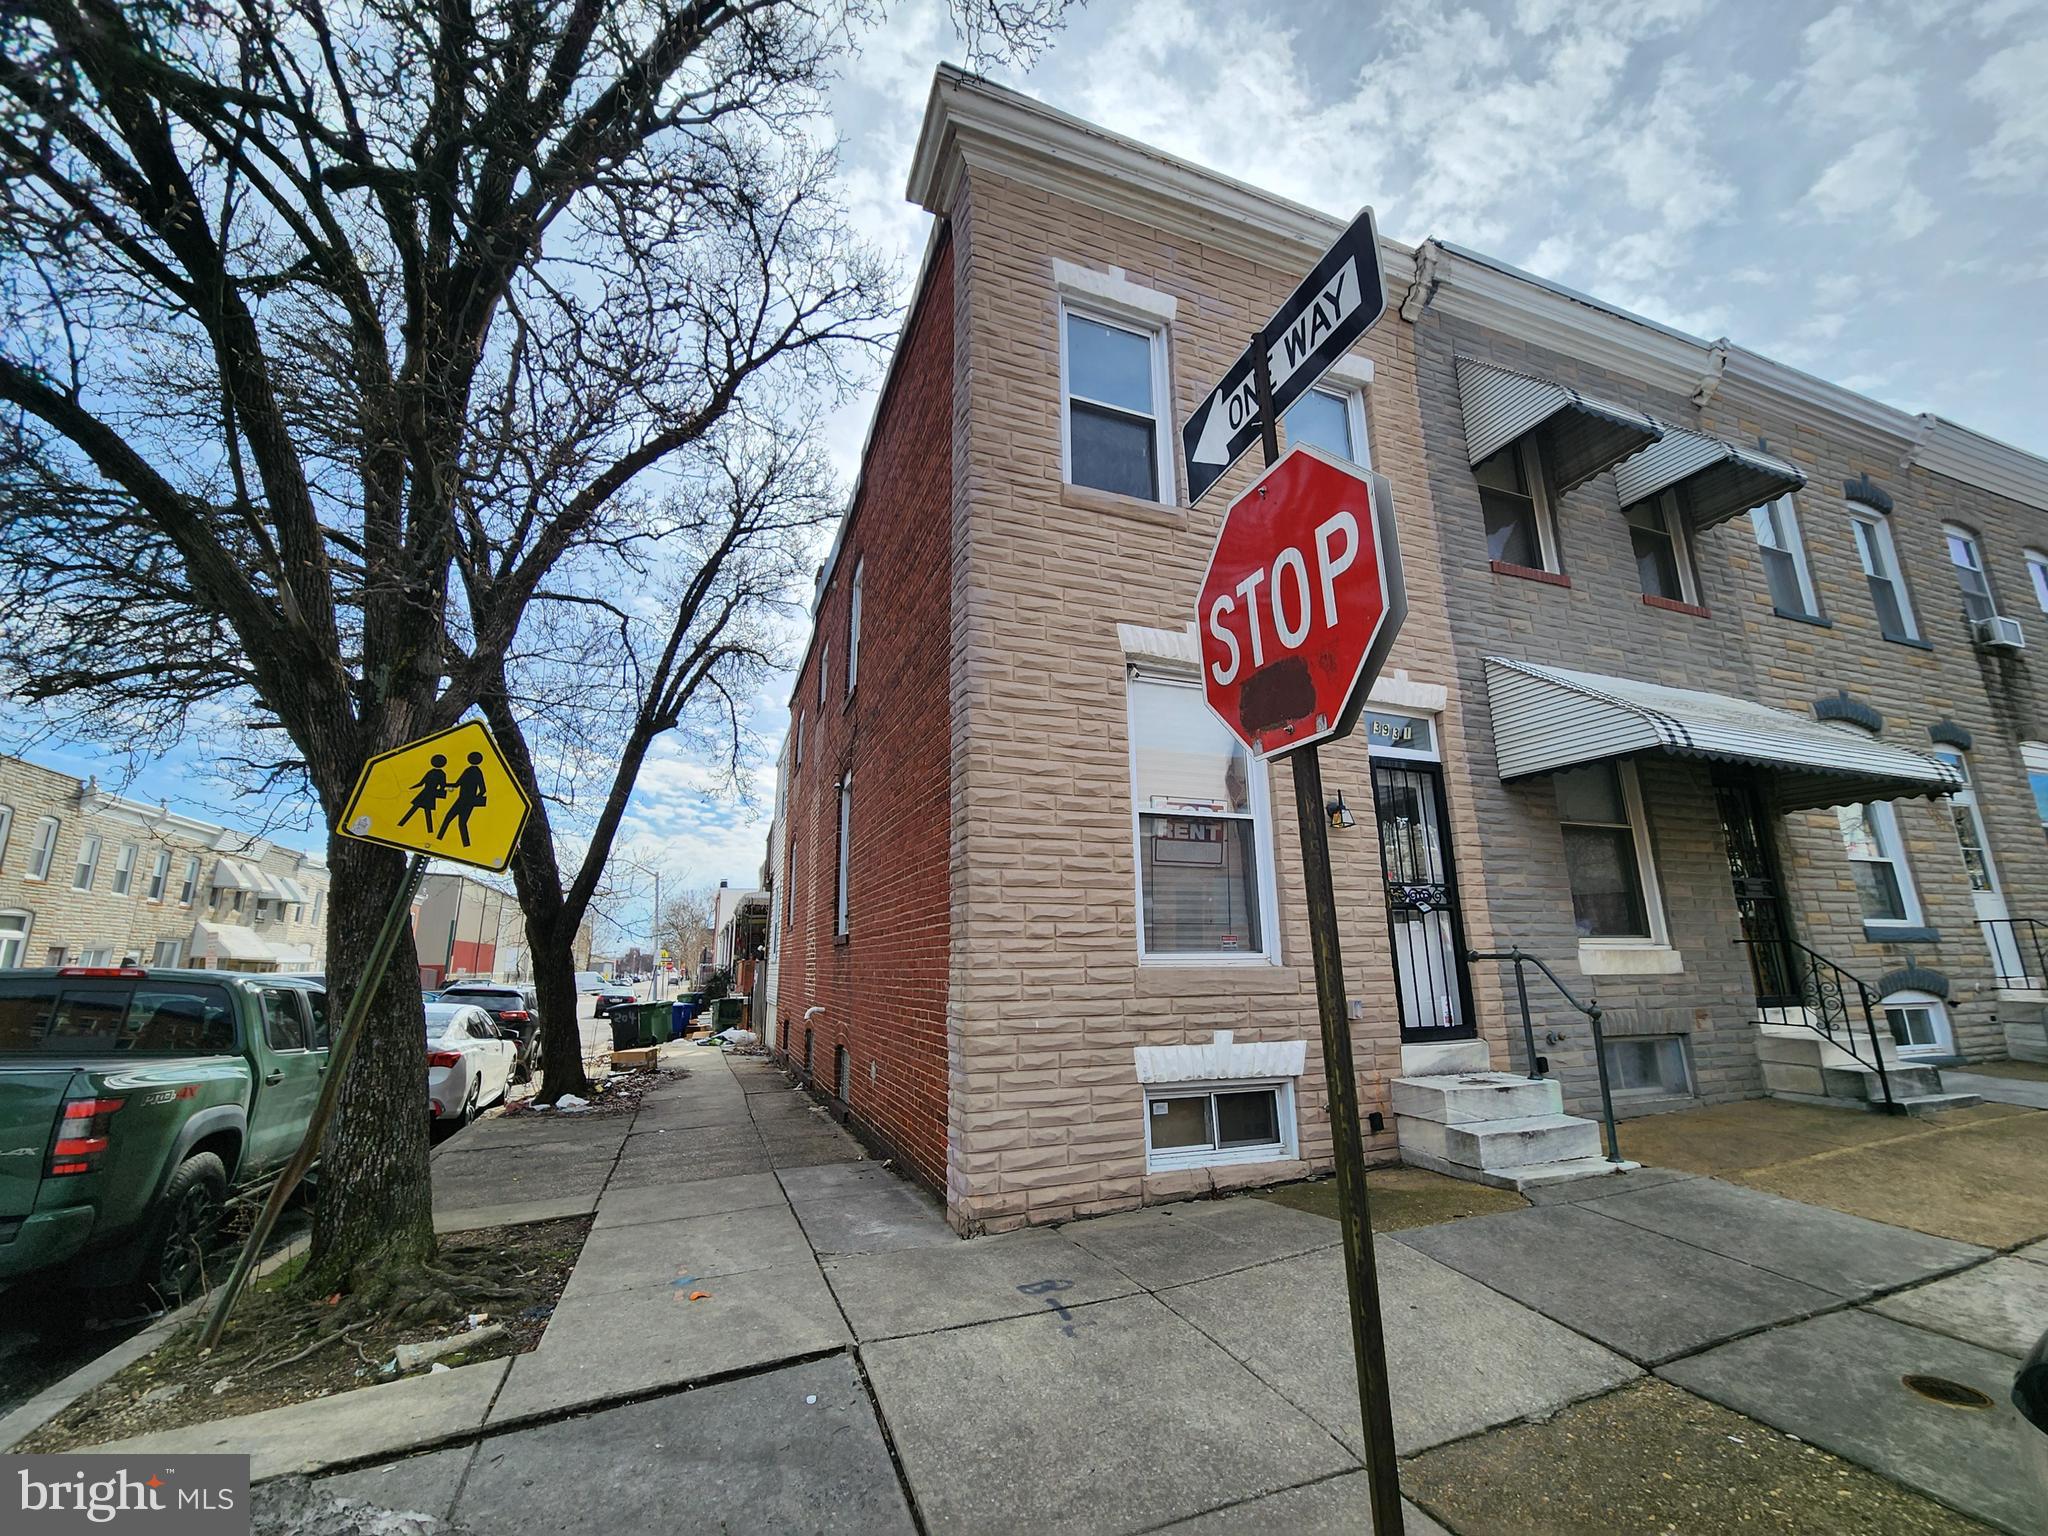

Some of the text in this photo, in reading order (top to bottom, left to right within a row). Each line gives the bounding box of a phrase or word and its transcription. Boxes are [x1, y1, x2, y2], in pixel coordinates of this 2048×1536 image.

[1284, 272, 1347, 369] WAY
[1209, 511, 1359, 686] STOP
[1373, 720, 1411, 740] 3931
[1161, 822, 1221, 841] RENT
